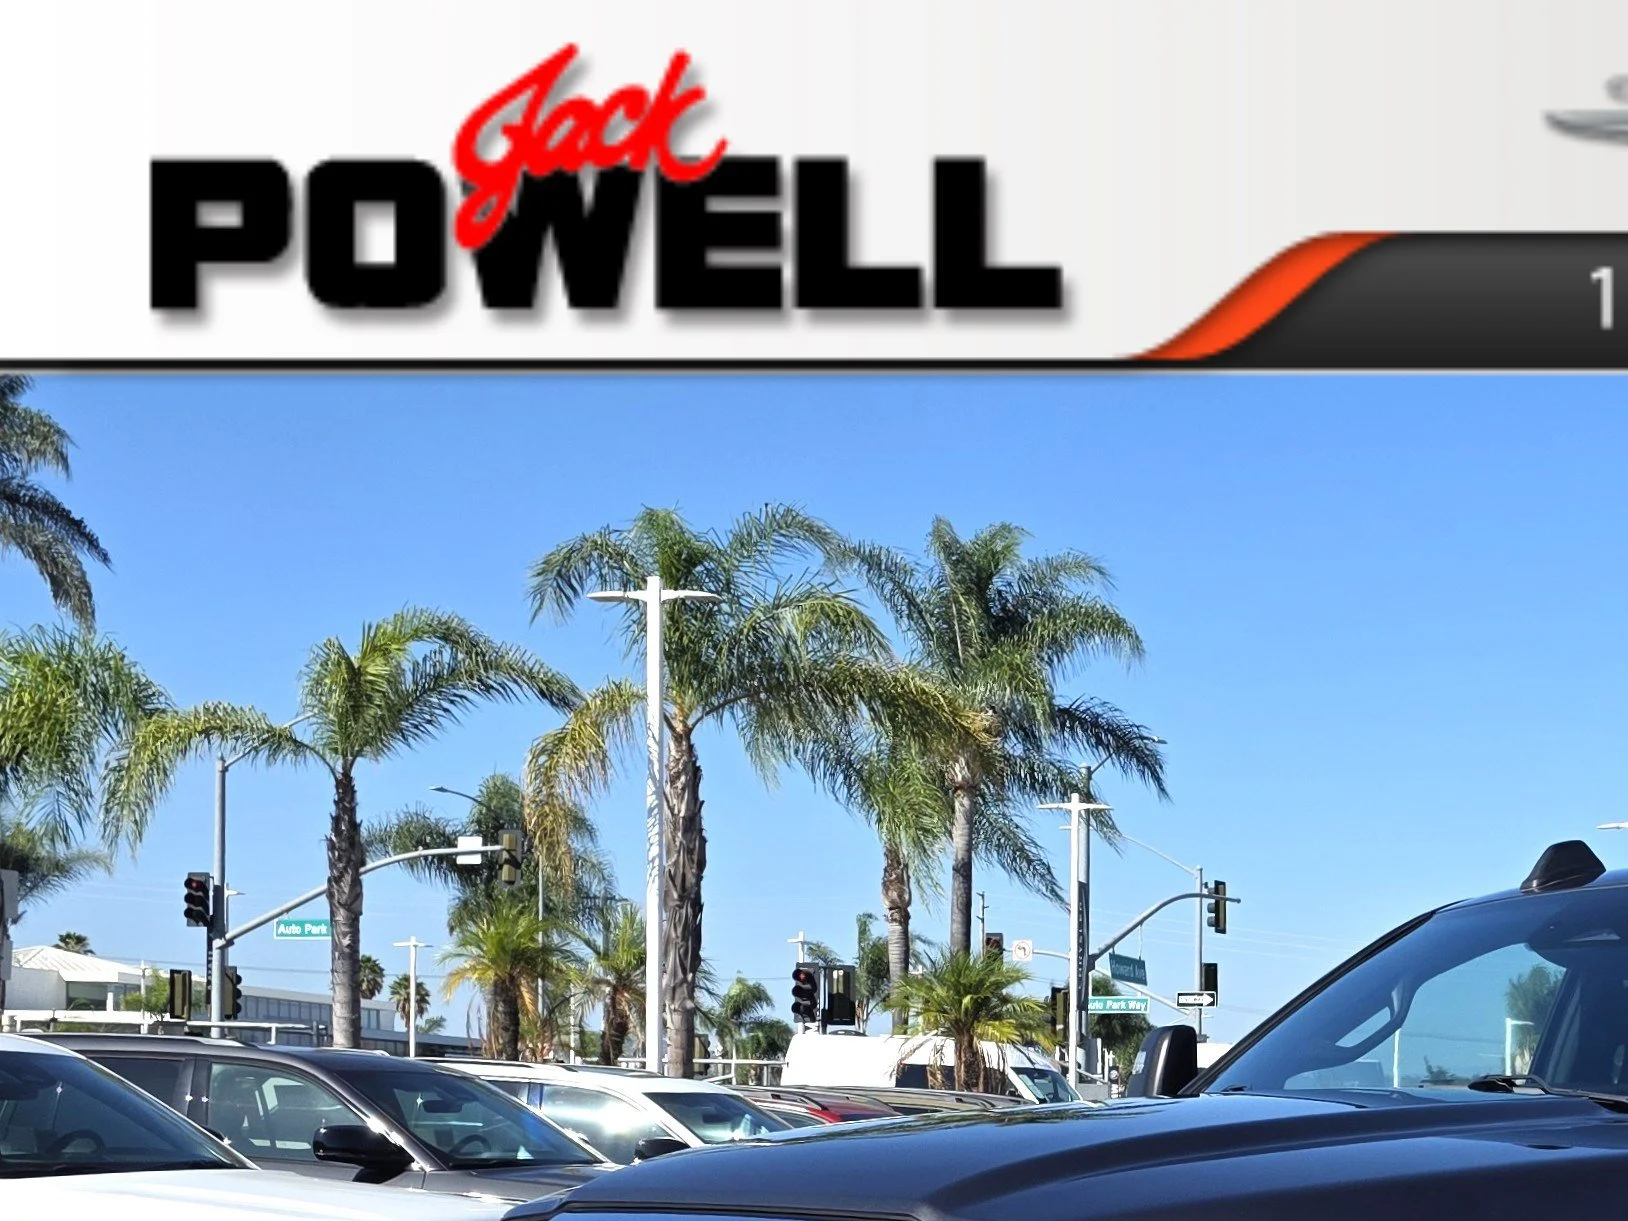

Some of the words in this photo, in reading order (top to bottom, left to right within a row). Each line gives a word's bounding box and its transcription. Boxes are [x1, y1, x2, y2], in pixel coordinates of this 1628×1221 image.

[277, 923, 302, 935] Auto
[304, 923, 328, 935] Park
[1088, 1000, 1104, 1010] uto
[1105, 1000, 1126, 1010] Park
[1128, 1000, 1147, 1012] Way
